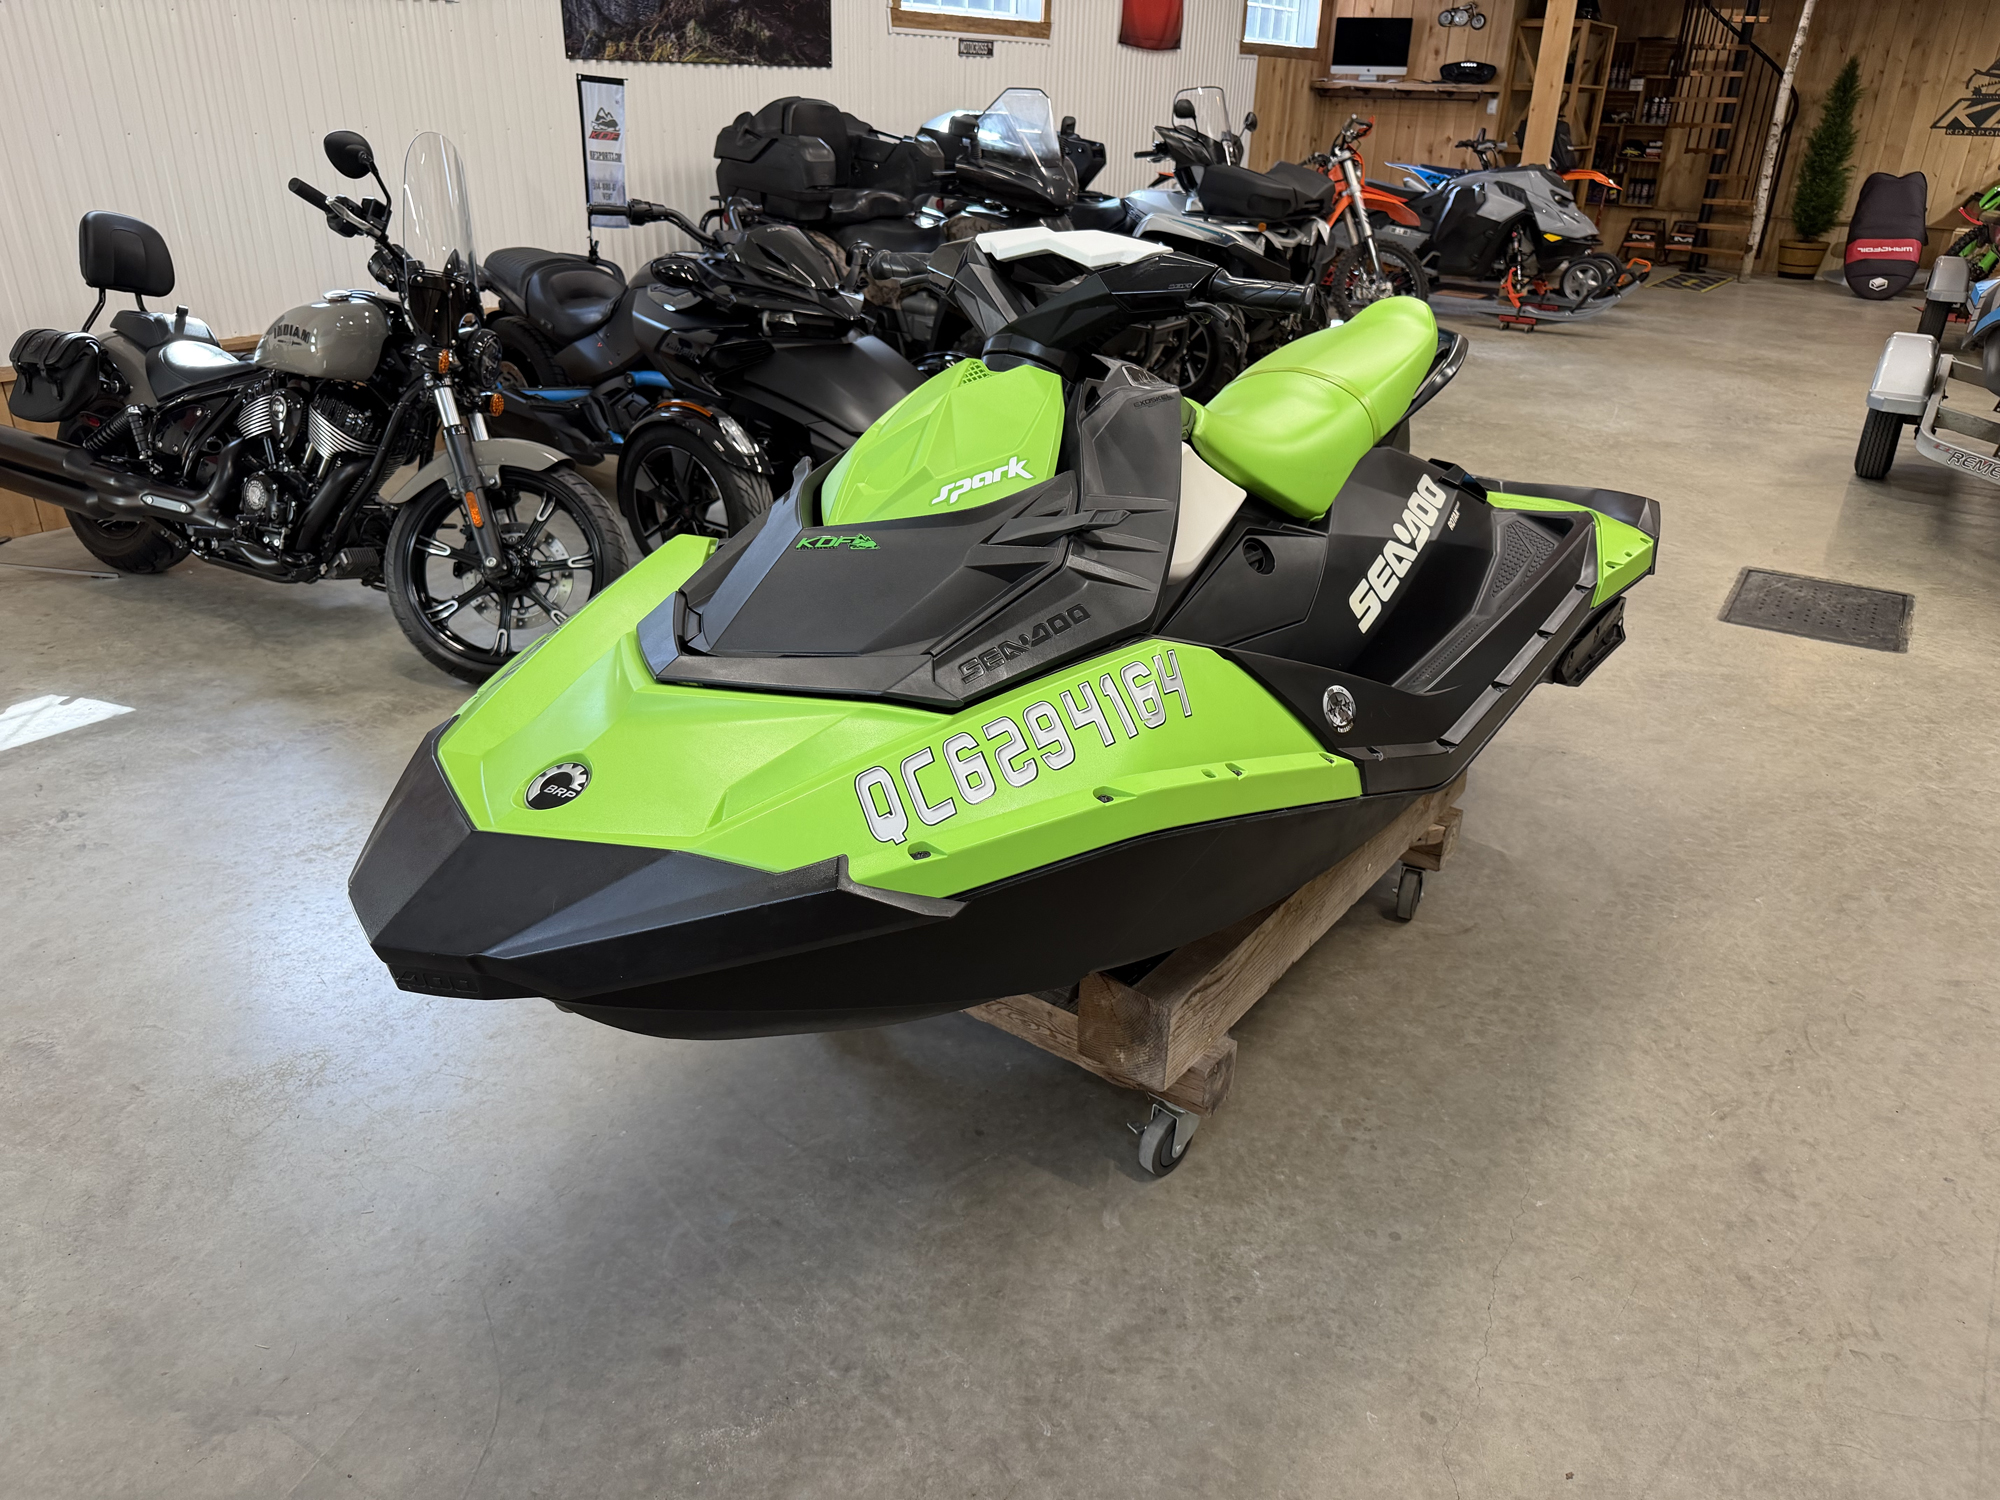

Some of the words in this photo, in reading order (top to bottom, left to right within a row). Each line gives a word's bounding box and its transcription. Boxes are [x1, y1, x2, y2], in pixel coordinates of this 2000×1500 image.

[588, 130, 621, 141] KDF
[273, 324, 310, 344] INDIAN
[854, 649, 1193, 846] QC6294164
[543, 784, 577, 798] BRP
